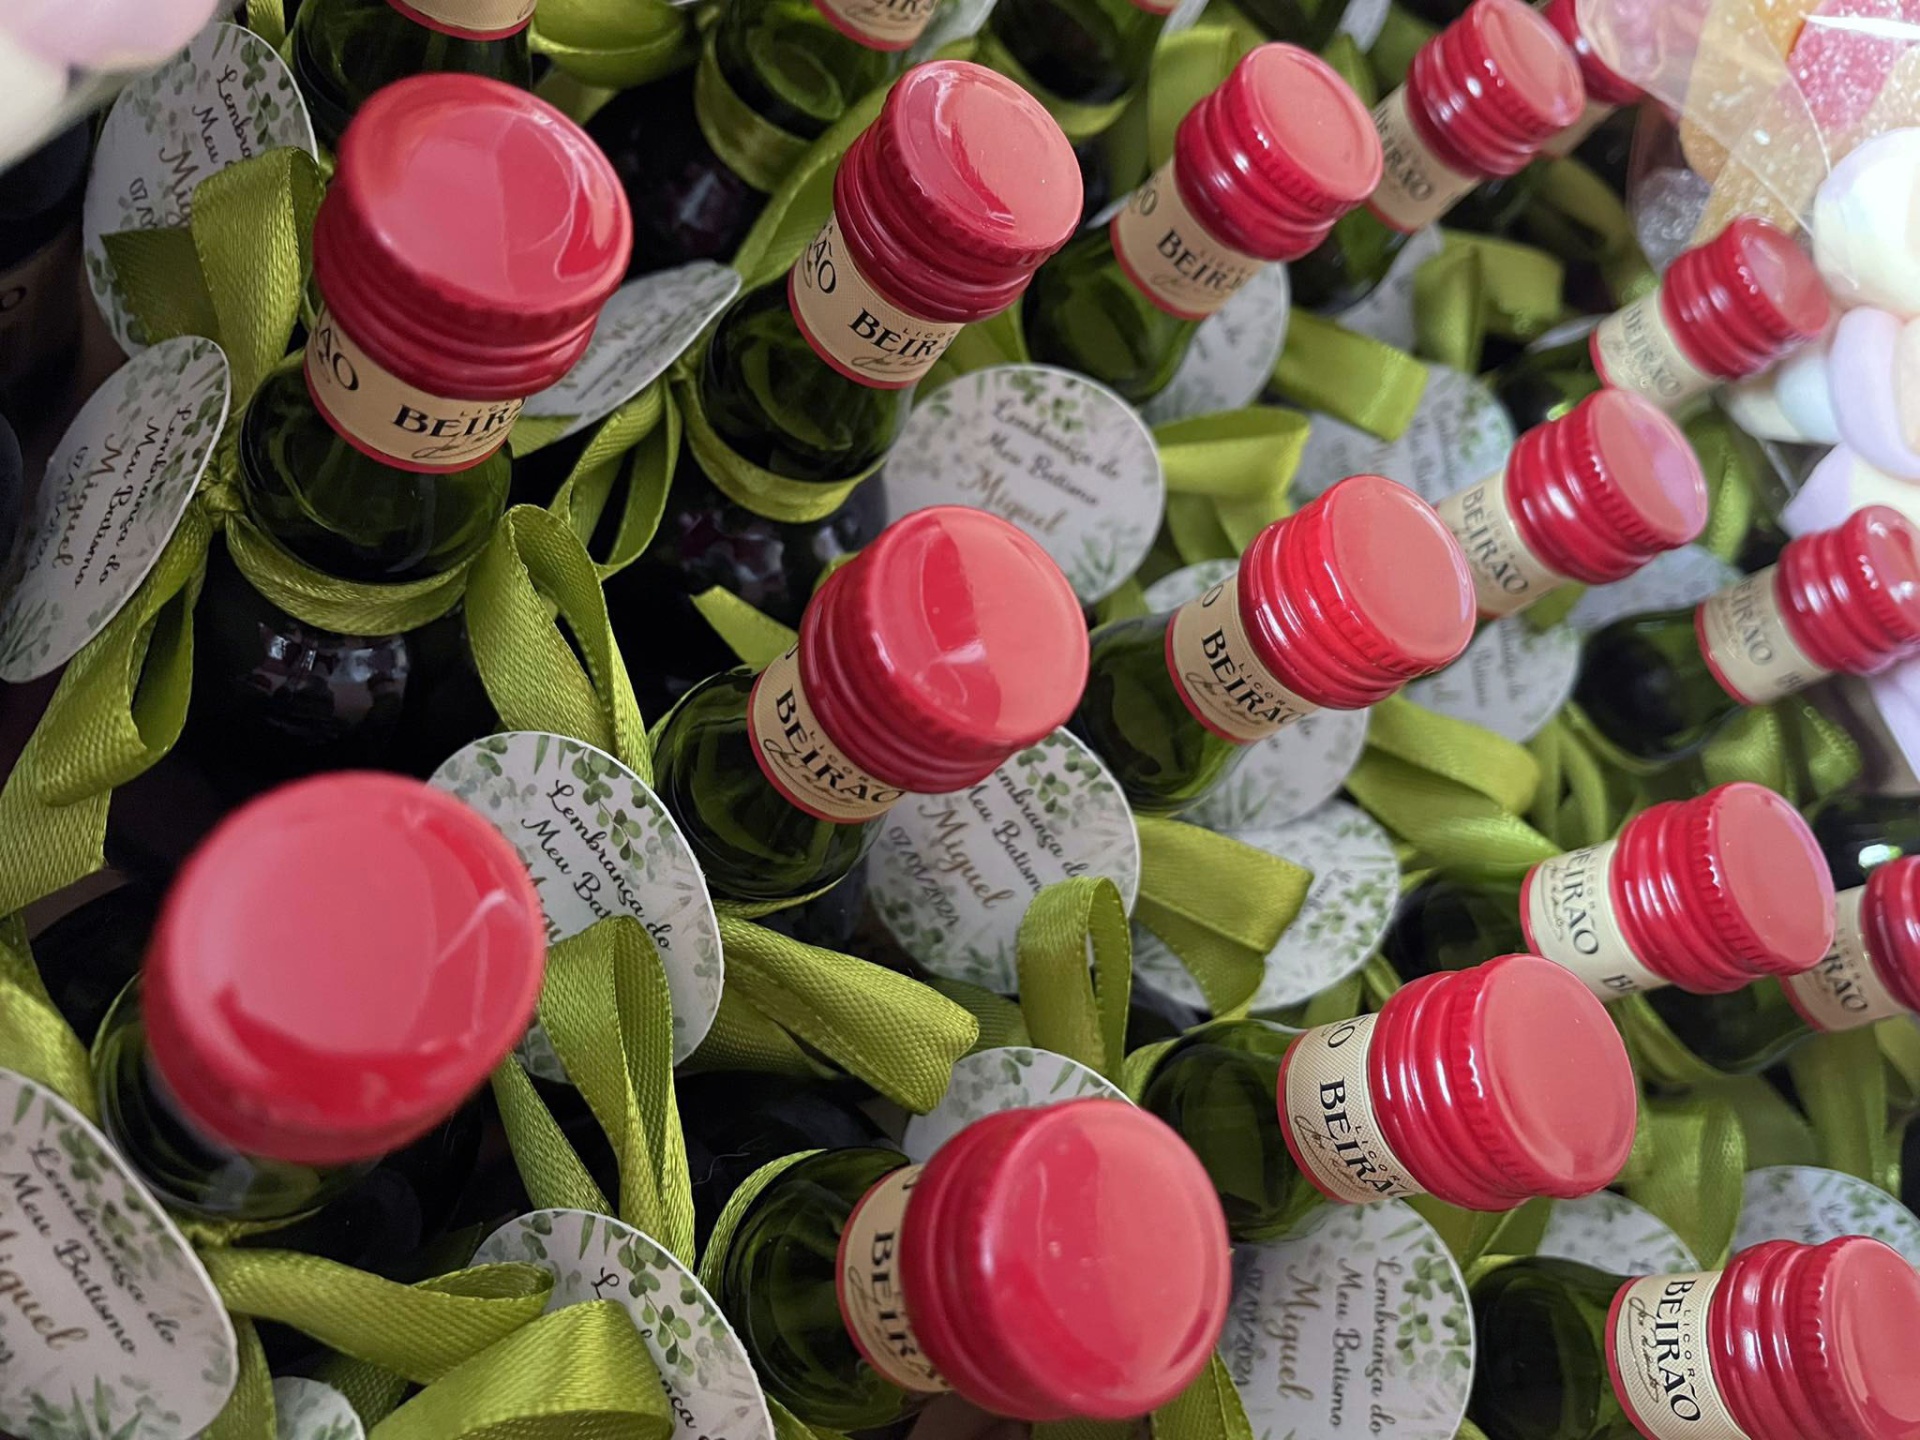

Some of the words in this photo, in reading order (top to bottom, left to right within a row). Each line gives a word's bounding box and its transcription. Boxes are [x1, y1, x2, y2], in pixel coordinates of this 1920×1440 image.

[192, 104, 219, 164] Meu
[217, 64, 254, 160] Lembra
[129, 178, 159, 228] 07/0
[158, 147, 199, 227] Mig
[847, 308, 940, 358] BEIR
[123, 416, 161, 480] Meu
[52, 433, 124, 569] Miguel
[74, 484, 134, 590] Batismo
[99, 554, 121, 586] do
[1731, 578, 1774, 666] EIRÃO
[1239, 661, 1286, 707] LICOR
[775, 684, 906, 803] BEIRÃO
[917, 803, 1016, 911] Miguel
[992, 819, 1042, 894] Batism
[994, 766, 1064, 860] embrança
[521, 817, 572, 876] Meu
[573, 871, 613, 921] Bat
[546, 779, 645, 920] Lembrança
[646, 921, 673, 952] do
[1355, 1125, 1402, 1183] LICOR
[0, 1170, 51, 1238] Meu
[54, 1238, 138, 1356] Batismo
[28, 1138, 146, 1306] Lembrança
[147, 1310, 181, 1346] do
[1335, 1257, 1364, 1321] Meu
[1263, 1263, 1323, 1401] Miguel
[1365, 1256, 1403, 1396] Lembrança
[1655, 1278, 1702, 1422] BEIRÃO
[1682, 1308, 1697, 1377] LICOR
[1329, 1327, 1362, 1430] Batismo
[1369, 1403, 1396, 1437] do
